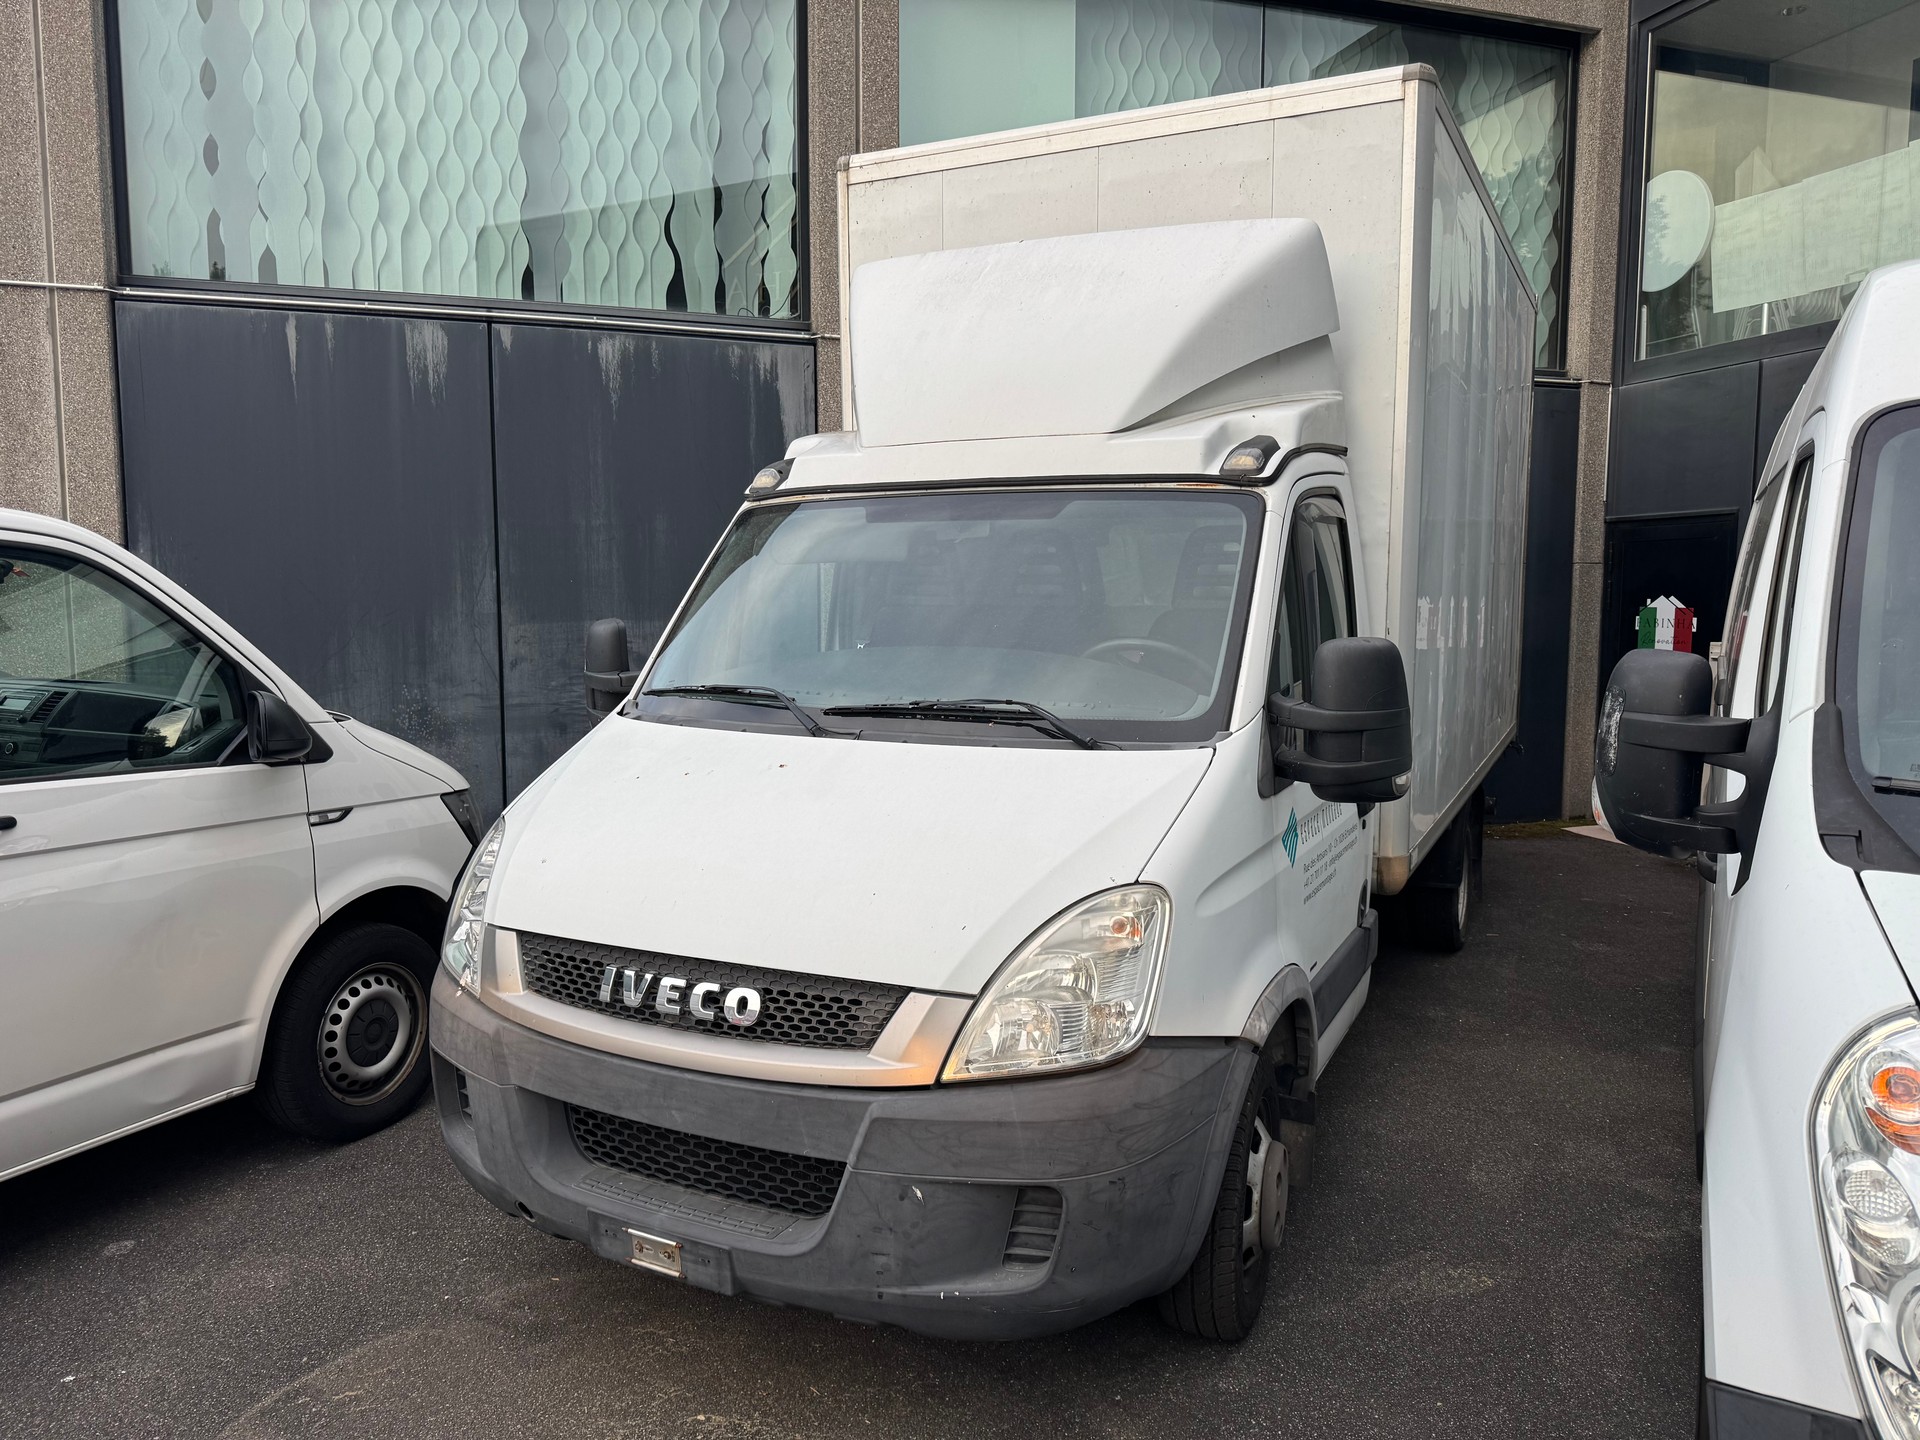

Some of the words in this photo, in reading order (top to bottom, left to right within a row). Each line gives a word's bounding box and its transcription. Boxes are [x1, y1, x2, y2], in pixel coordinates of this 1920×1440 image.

[1636, 617, 1695, 629] FABINHA
[1301, 813, 1320, 845] ESPACE
[599, 965, 762, 1027] IVECO
